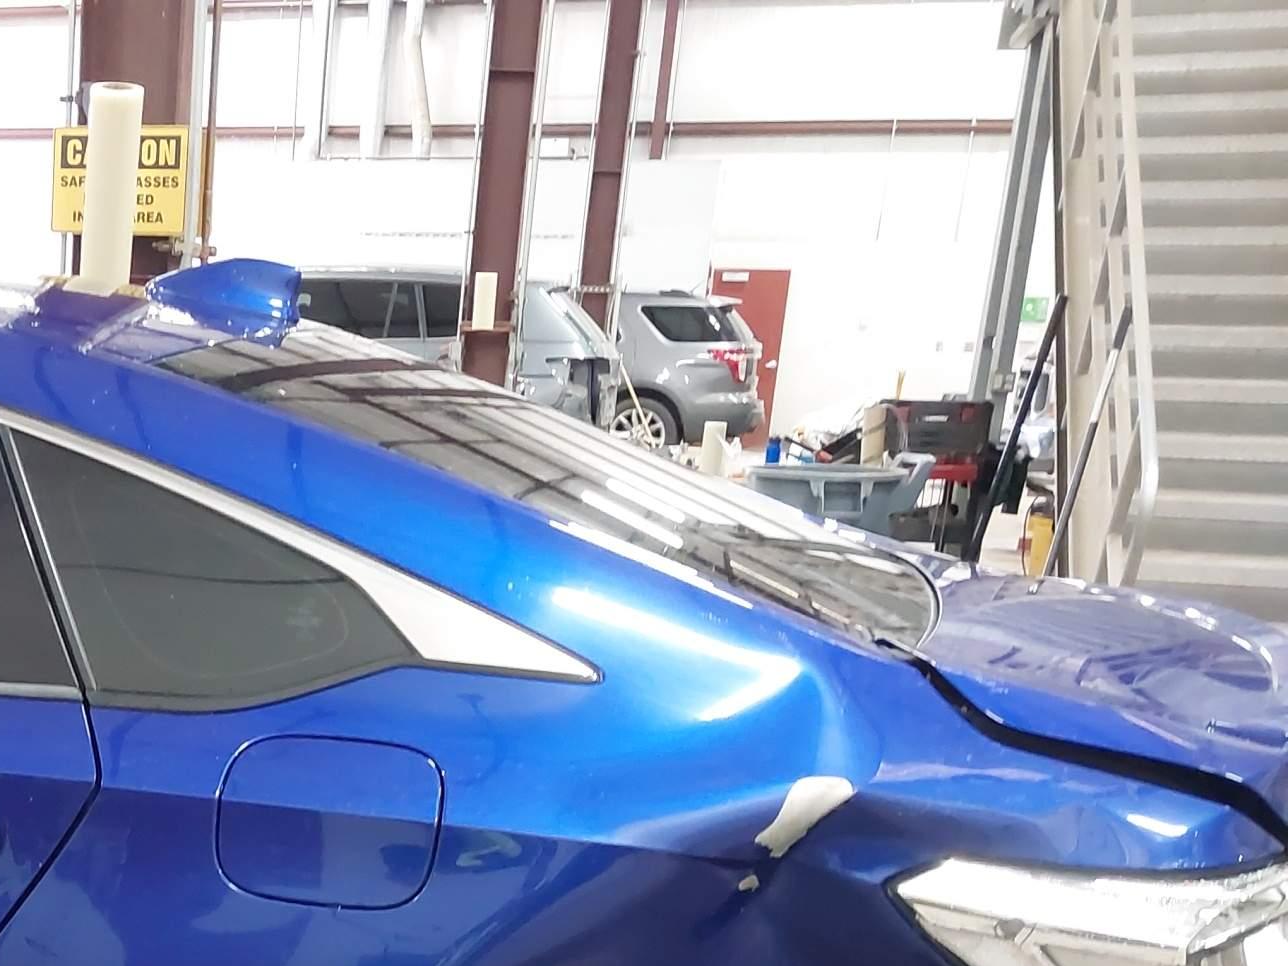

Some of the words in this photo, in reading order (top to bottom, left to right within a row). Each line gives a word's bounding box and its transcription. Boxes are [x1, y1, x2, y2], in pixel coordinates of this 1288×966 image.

[61, 176, 86, 188] SAF
[136, 176, 179, 188] ASSES
[133, 212, 164, 223] REA
